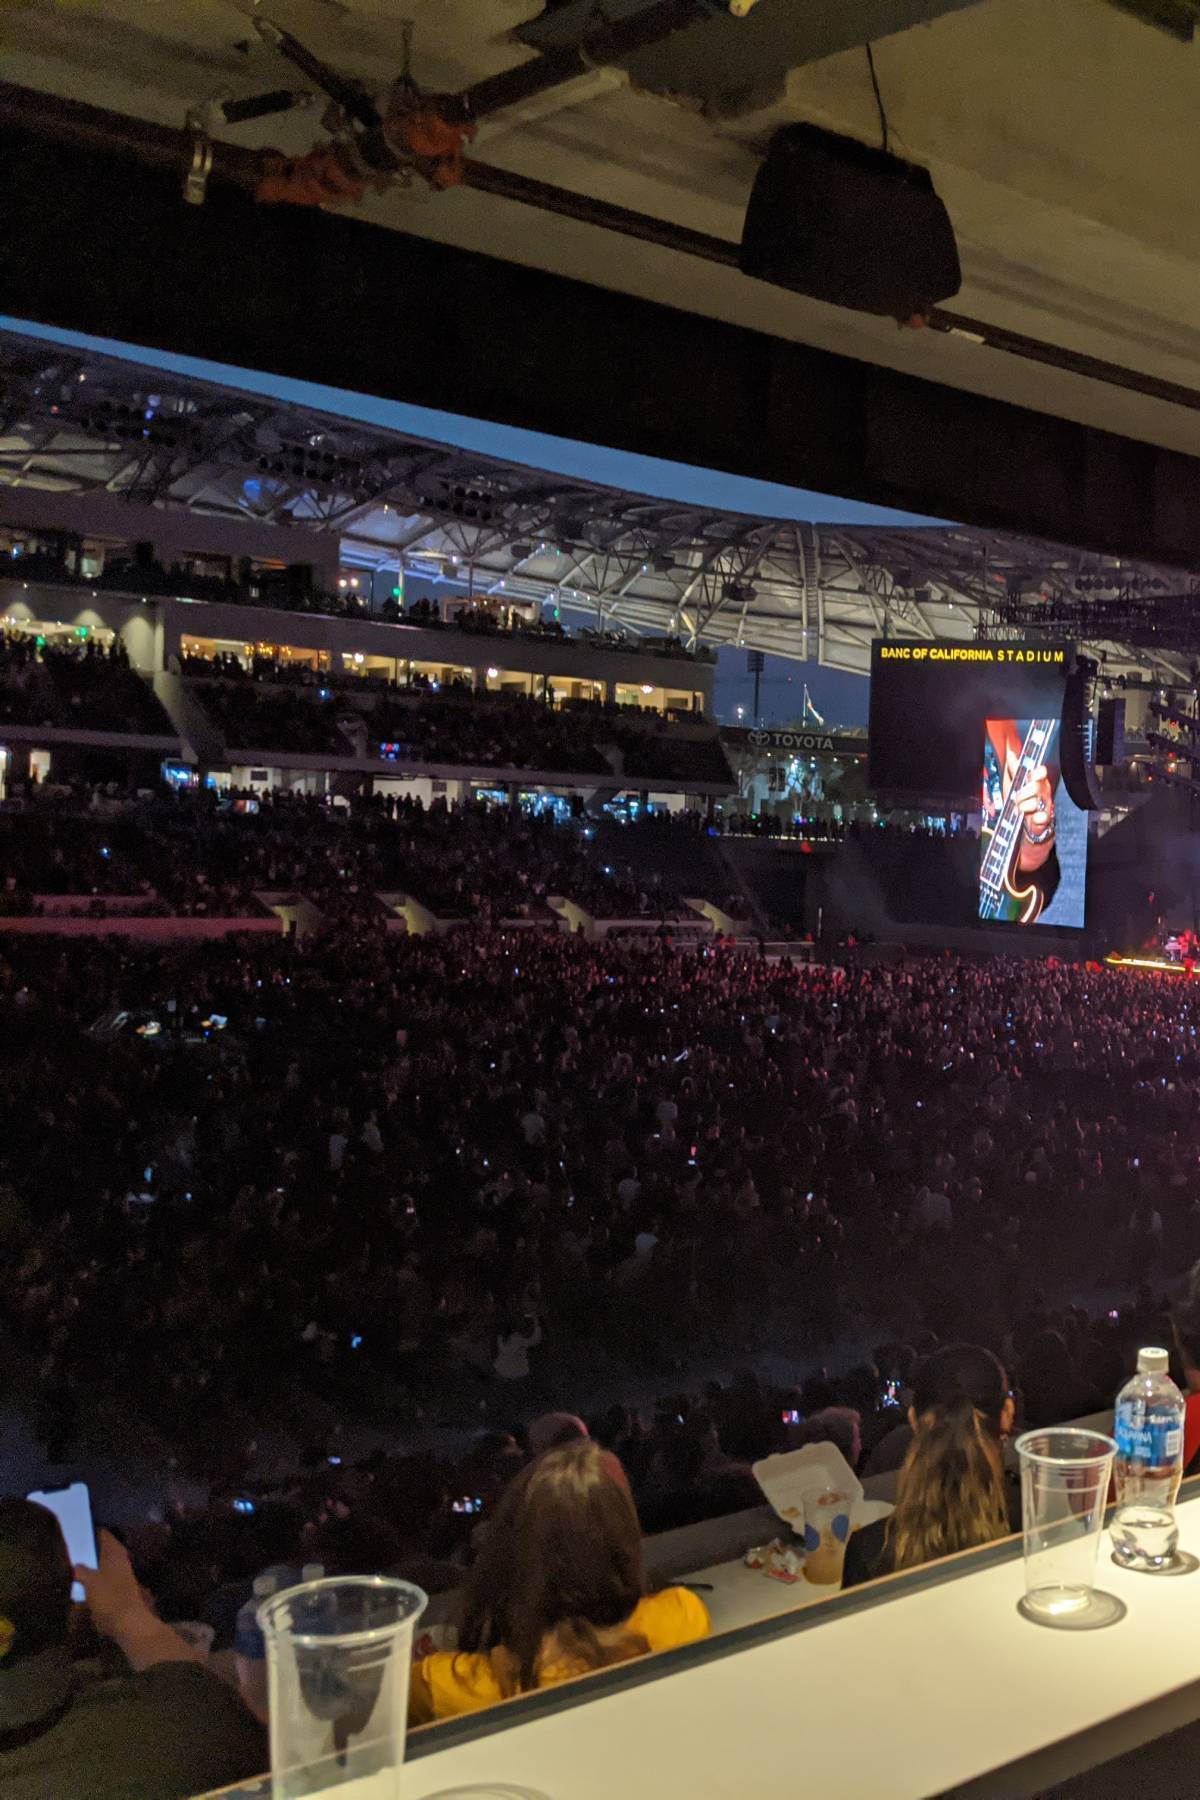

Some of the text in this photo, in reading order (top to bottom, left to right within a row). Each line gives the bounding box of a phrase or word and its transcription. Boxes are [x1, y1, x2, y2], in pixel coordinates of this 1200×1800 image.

[881, 647, 1064, 662] BANC OF CALIFORNIA STADIUM
[773, 733, 834, 750] TOYOTA
